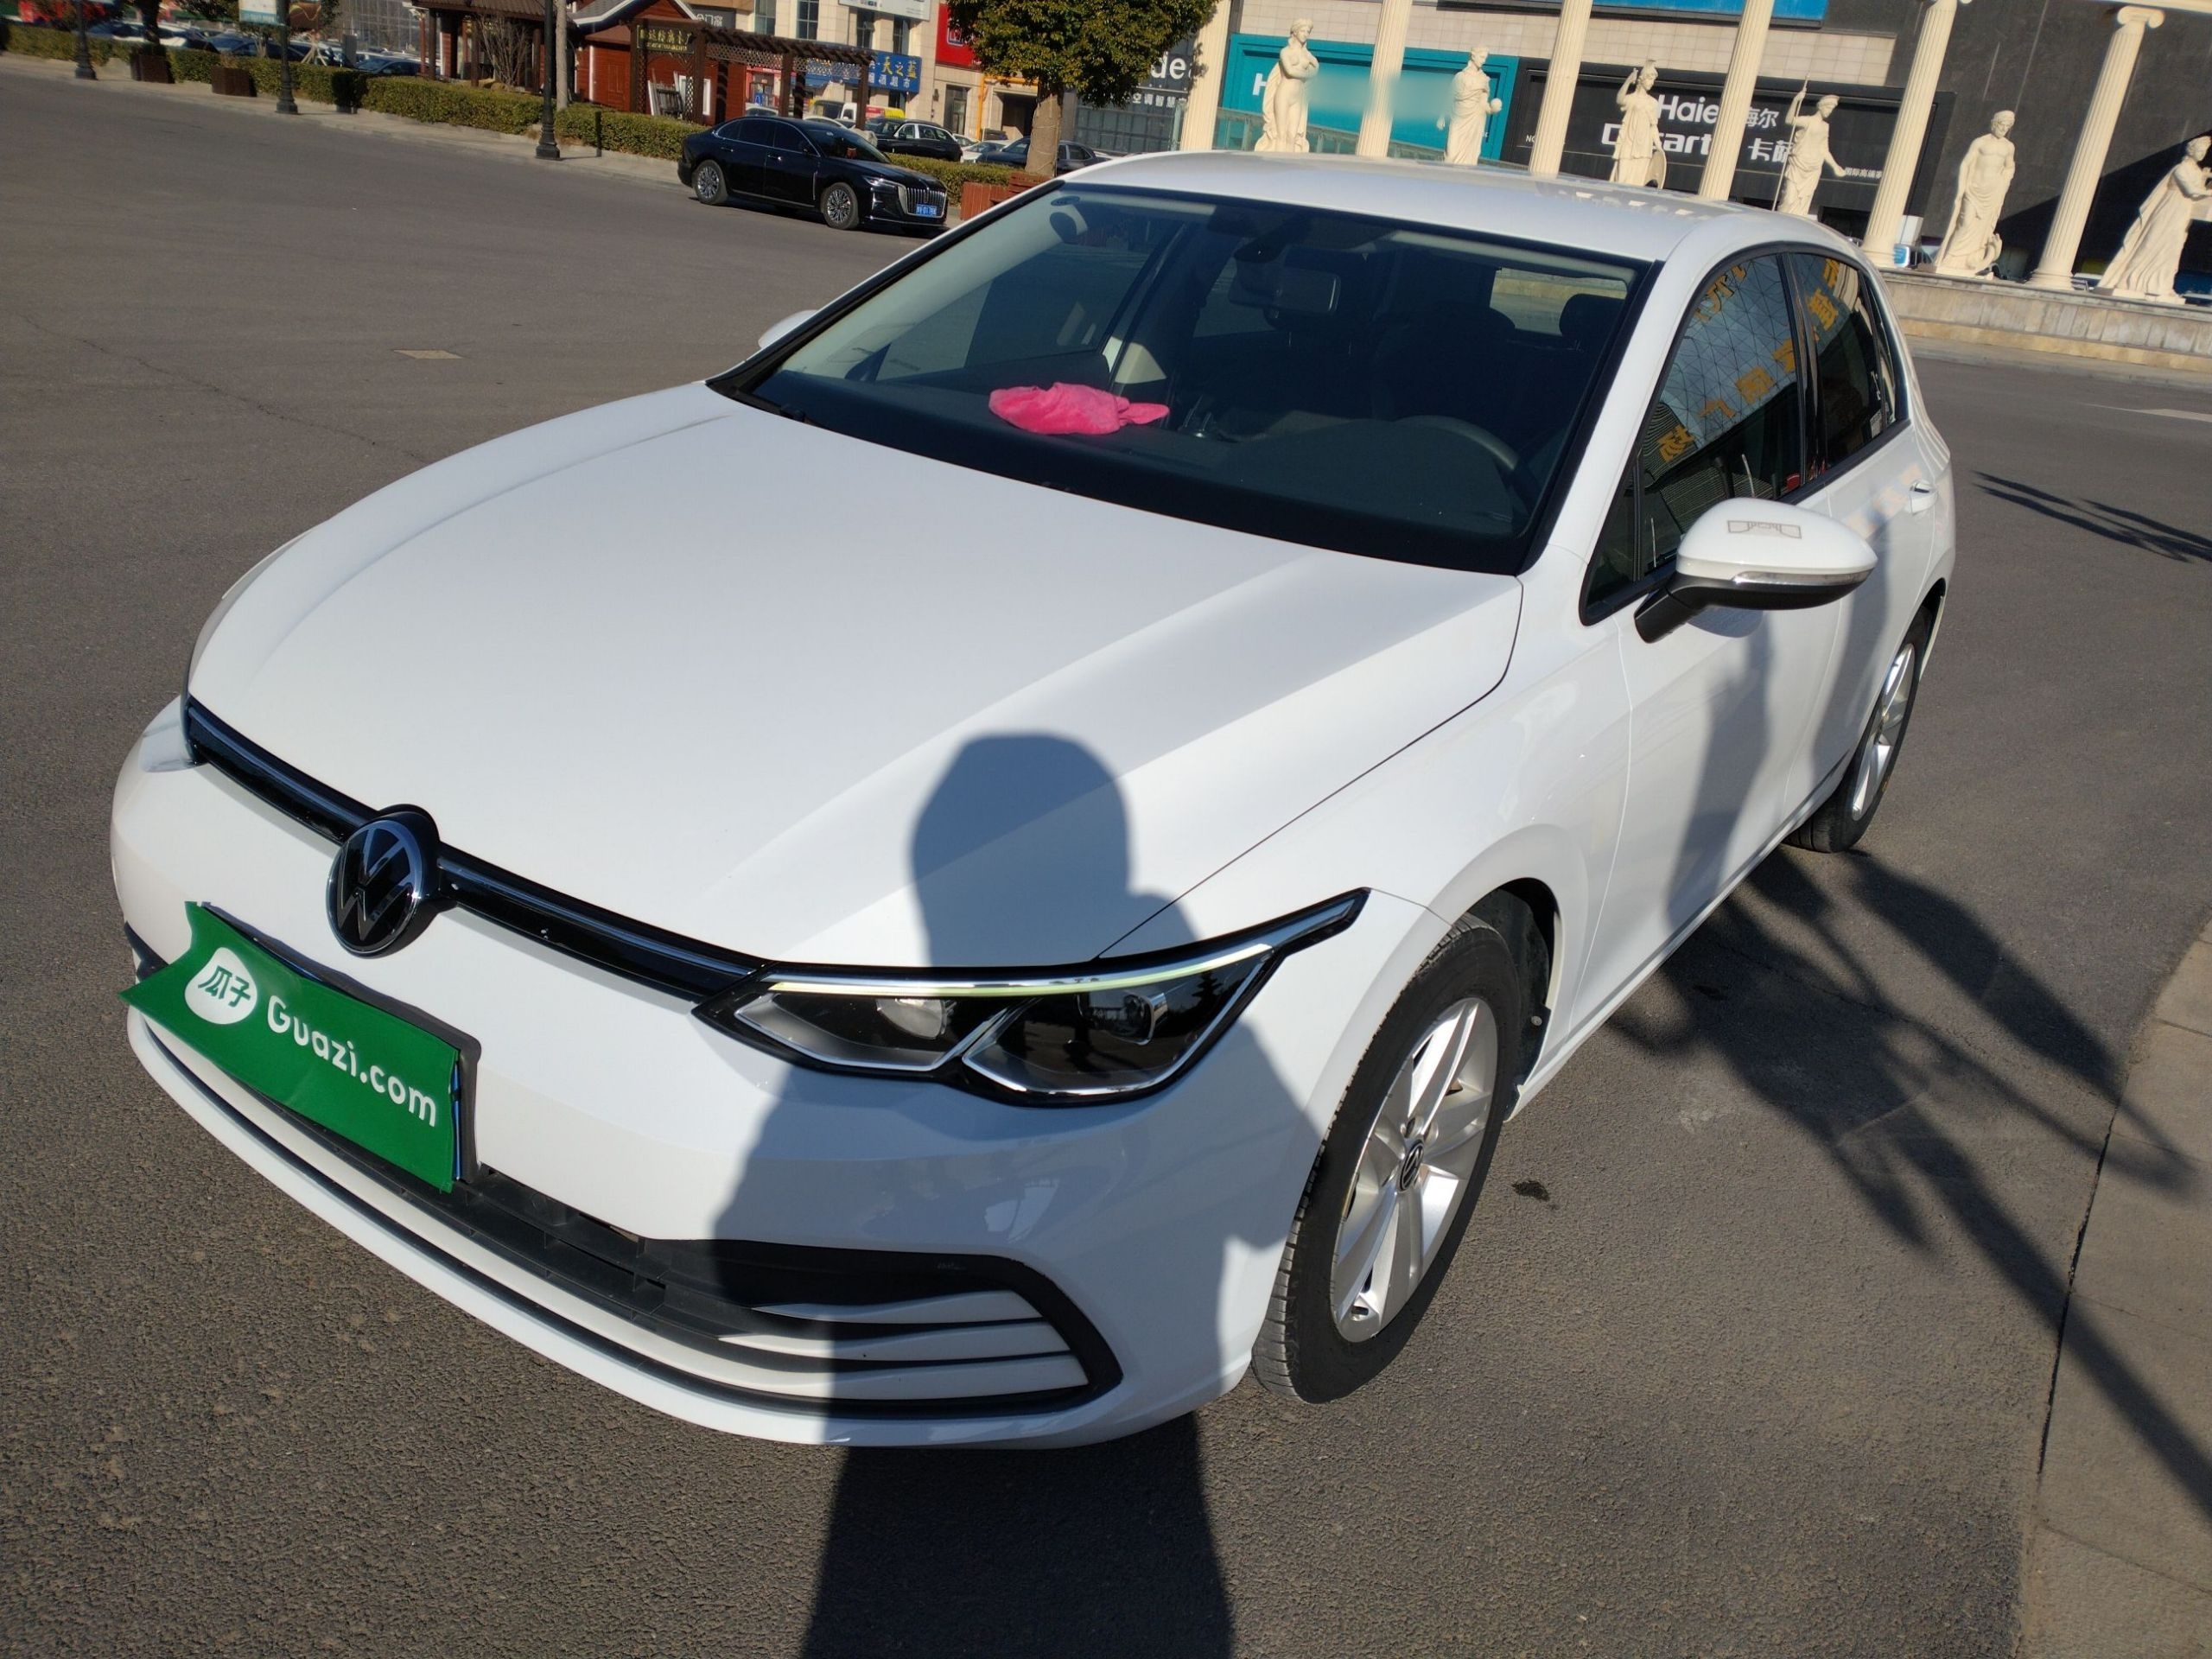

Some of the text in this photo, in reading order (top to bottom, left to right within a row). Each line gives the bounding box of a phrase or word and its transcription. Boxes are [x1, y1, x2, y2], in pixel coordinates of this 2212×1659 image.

[1150, 51, 1192, 79] de
[1658, 94, 1719, 124] Haie
[1747, 137, 1794, 163] 卡萨
[197, 965, 251, 1008] 瓜子
[266, 995, 437, 1128] Guazi.com
